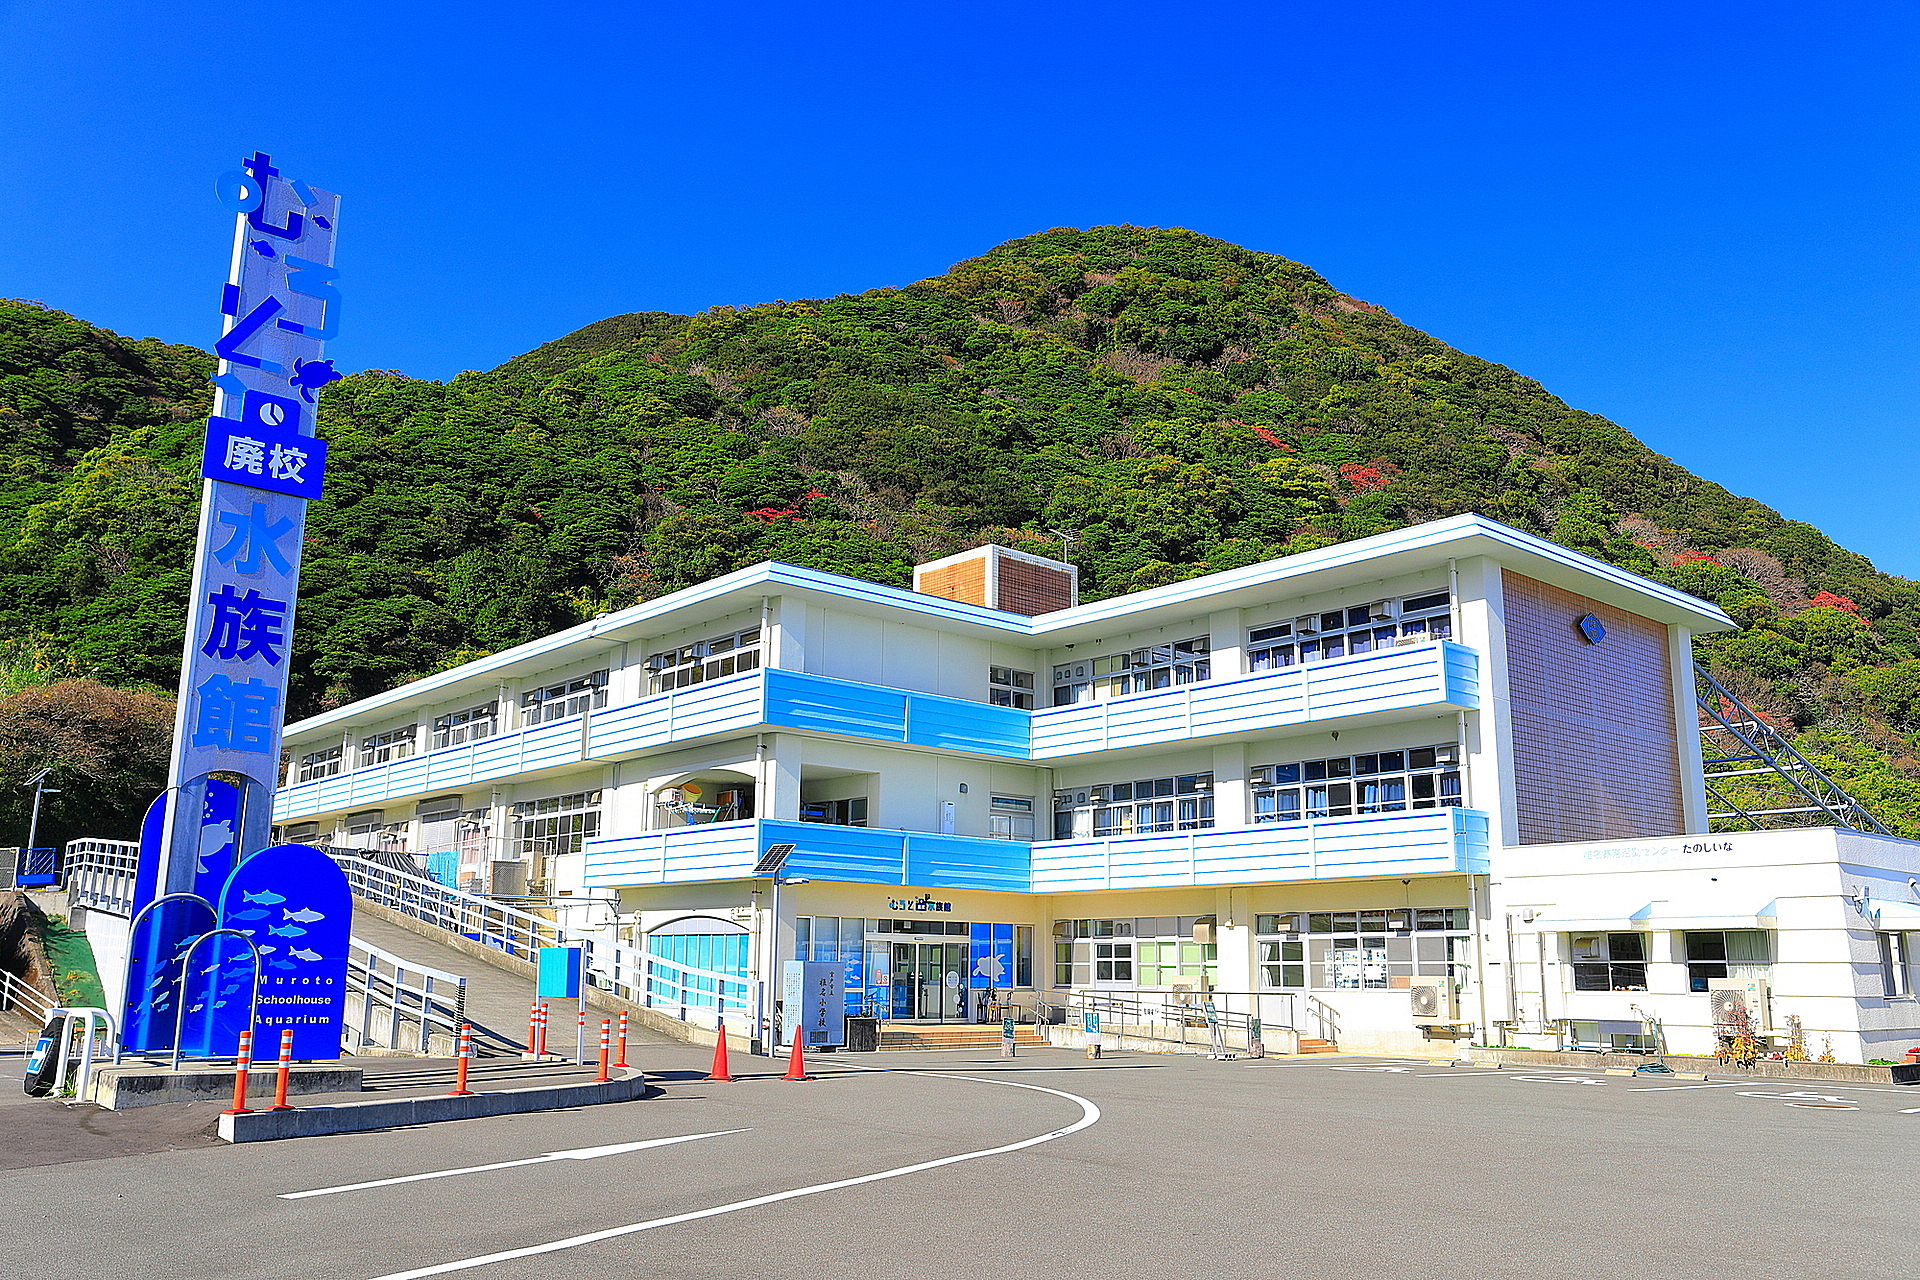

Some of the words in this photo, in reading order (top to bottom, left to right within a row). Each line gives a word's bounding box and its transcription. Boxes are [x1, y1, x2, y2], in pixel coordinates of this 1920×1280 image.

[223, 434, 308, 484] 廃校
[191, 501, 297, 756] 水族館
[1683, 842, 1733, 854] たのしいな
[259, 975, 333, 985] Muroto
[257, 994, 332, 1005] Schoolhouse
[255, 1014, 330, 1026] Aquarium
